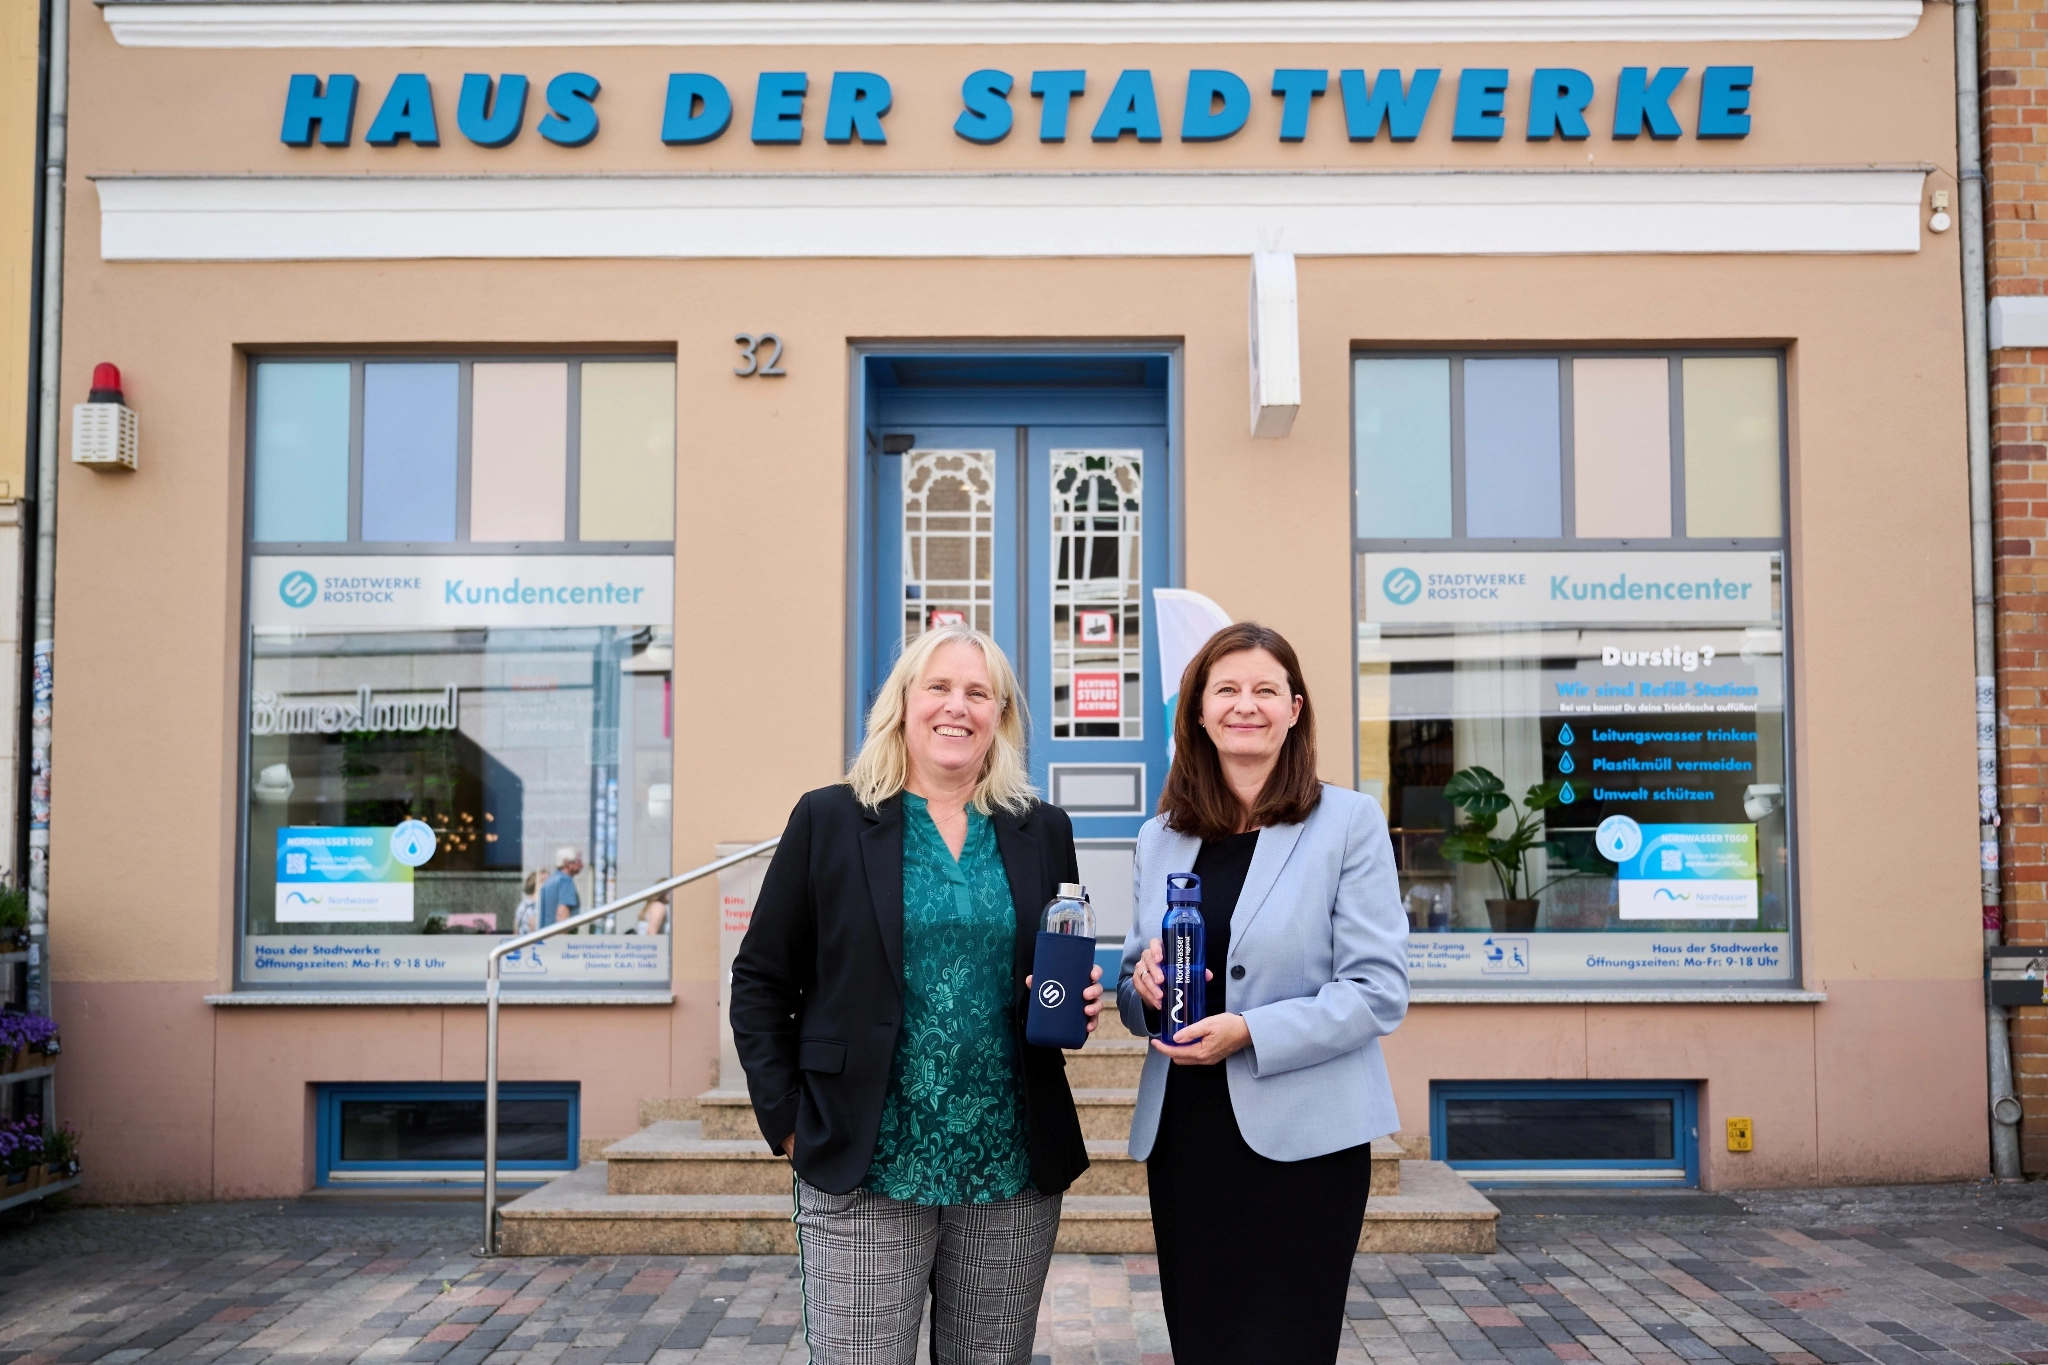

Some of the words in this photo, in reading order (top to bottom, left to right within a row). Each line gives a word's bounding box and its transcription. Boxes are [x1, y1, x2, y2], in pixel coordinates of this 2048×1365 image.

[280, 72, 602, 148] HAUS
[661, 71, 893, 146] DER
[953, 66, 1755, 147] STADTWERKE
[733, 332, 787, 378] 32
[324, 577, 422, 590] STADTWERKE
[1428, 573, 1526, 586] STADTWERKE
[444, 577, 645, 605] Kundencenter
[1550, 573, 1753, 601] Kundencenter
[323, 591, 395, 603] ROSTOCK
[1428, 588, 1499, 600] ROSTOCK
[1601, 644, 1716, 673] Durstig?
[1077, 679, 1118, 688] ACHTUNG
[1556, 681, 1590, 697] Wir
[1596, 681, 1635, 697] sind
[1641, 681, 1760, 698] Refill-Station
[1077, 689, 1118, 701] STUFE!
[1077, 701, 1118, 711] ACHTUNG
[1559, 703, 1574, 712] Bei
[1575, 704, 1591, 713] uns
[1593, 702, 1623, 712] kannst
[1624, 704, 1636, 712] Du
[1638, 703, 1662, 712] deine
[1663, 703, 1715, 712] Trinkflasche
[1716, 702, 1758, 712] auffüllen!
[1592, 729, 1702, 745] Leitungswasser
[1706, 728, 1759, 742] trinken
[1592, 757, 1673, 771] Plastikmüll
[1676, 757, 1753, 771] vermeiden
[1593, 787, 1649, 801] Umwelt
[1653, 786, 1715, 801] schützen
[287, 837, 348, 847] NORDWASSER
[1661, 833, 1723, 843] NORDWASSER
[1724, 833, 1748, 843] TOGO
[724, 896, 746, 905] Bitte
[1695, 892, 1747, 901] Nordwasser
[724, 909, 752, 919] Trepp
[724, 923, 749, 931] freih
[255, 945, 285, 955] Haus
[289, 945, 308, 955] der
[313, 945, 381, 955] Stadtwerke
[626, 943, 657, 952] Zugang
[1432, 942, 1464, 951] Zugang
[1652, 944, 1682, 953] Haus
[1686, 943, 1706, 953] der
[1710, 943, 1778, 953] Stadtwerke
[1175, 935, 1184, 984] Nordwasser
[1427, 952, 1470, 961] Katthagen
[1586, 955, 1680, 970] Öffnungszeiten:
[1684, 957, 1721, 967] Mo-Fr:
[1726, 957, 1753, 967] 9-18
[1757, 957, 1779, 967] Uhr
[255, 957, 348, 971] Öffnungszeiten:
[352, 959, 389, 969] Mo-Fr:
[394, 958, 421, 968] 9-18
[425, 958, 446, 968] Uhr
[585, 961, 611, 970] (hinter
[638, 961, 657, 969] links
